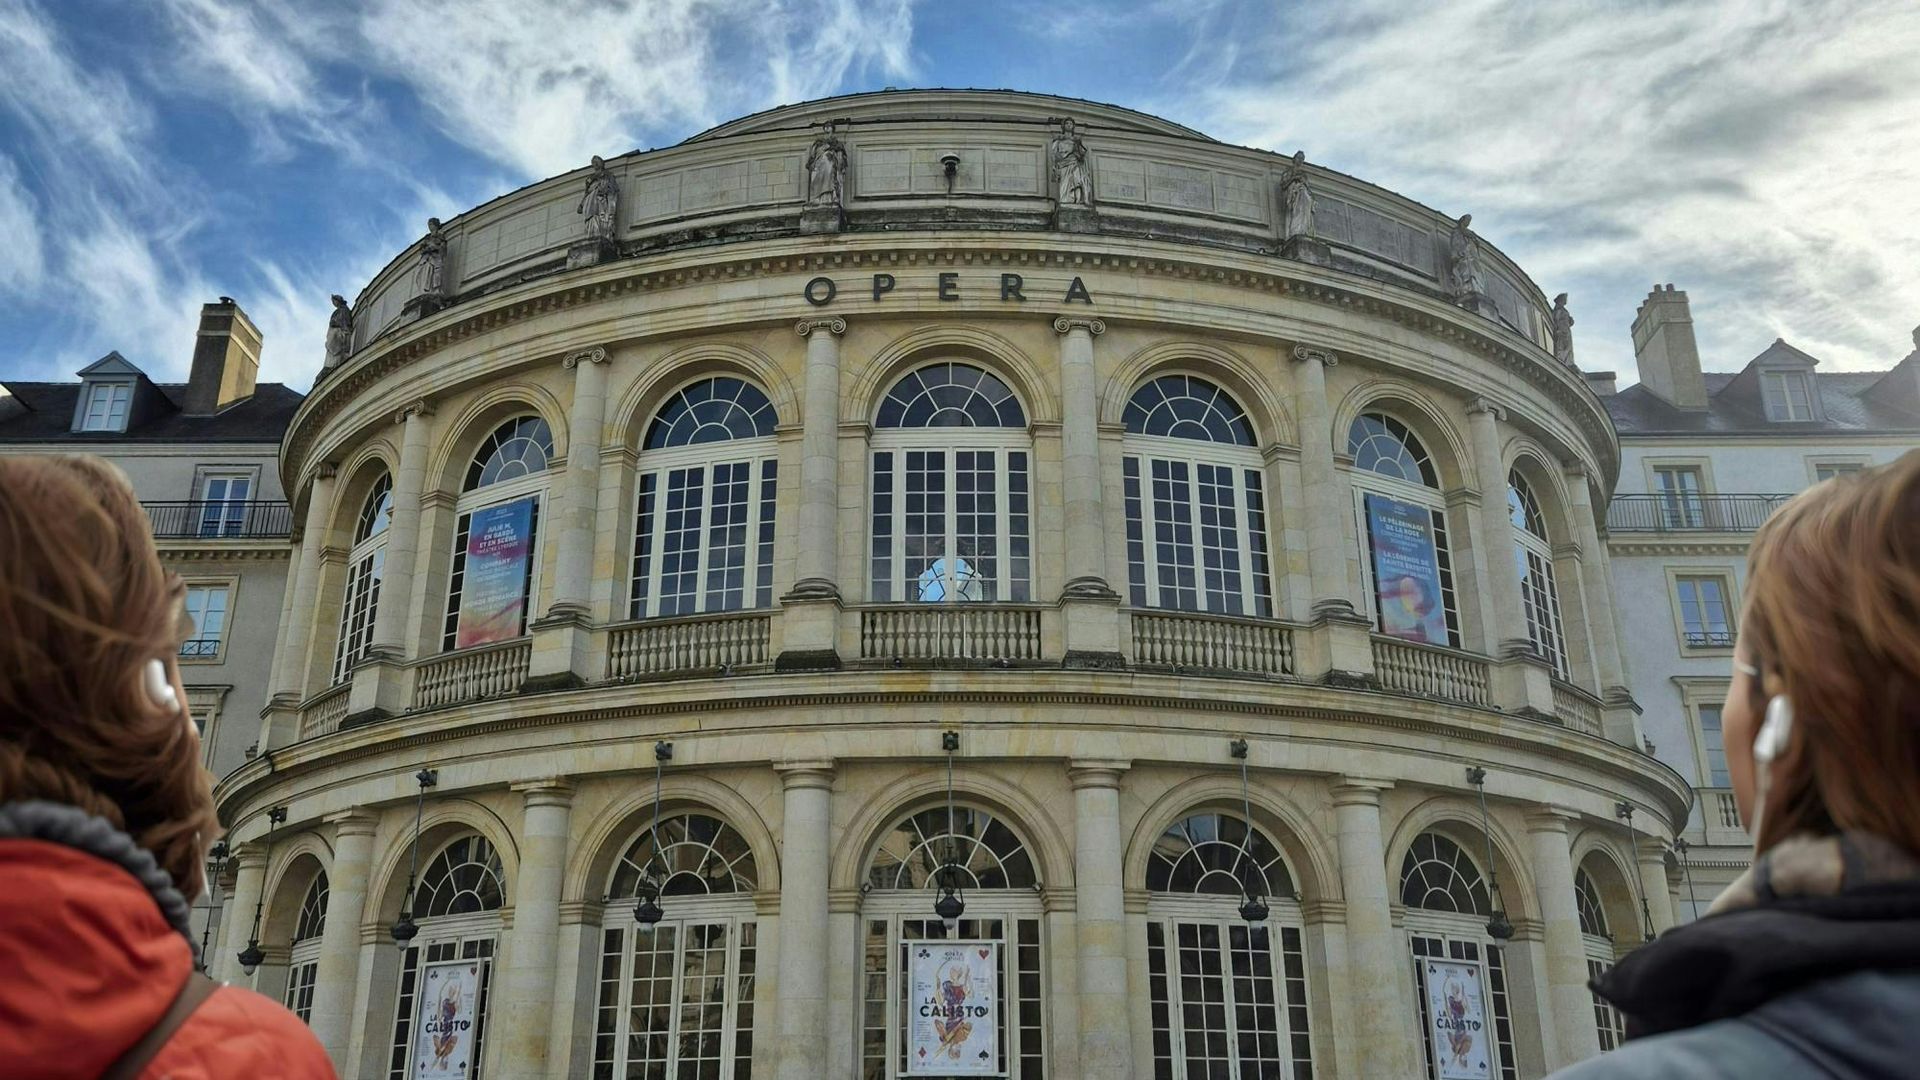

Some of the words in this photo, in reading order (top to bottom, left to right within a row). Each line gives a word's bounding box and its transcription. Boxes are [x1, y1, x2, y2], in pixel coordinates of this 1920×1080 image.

[804, 272, 1093, 306] OPERA
[920, 1006, 988, 1017] CALISTO
[426, 1020, 470, 1033] CALISTO
[1436, 1018, 1481, 1031] CALISTO
